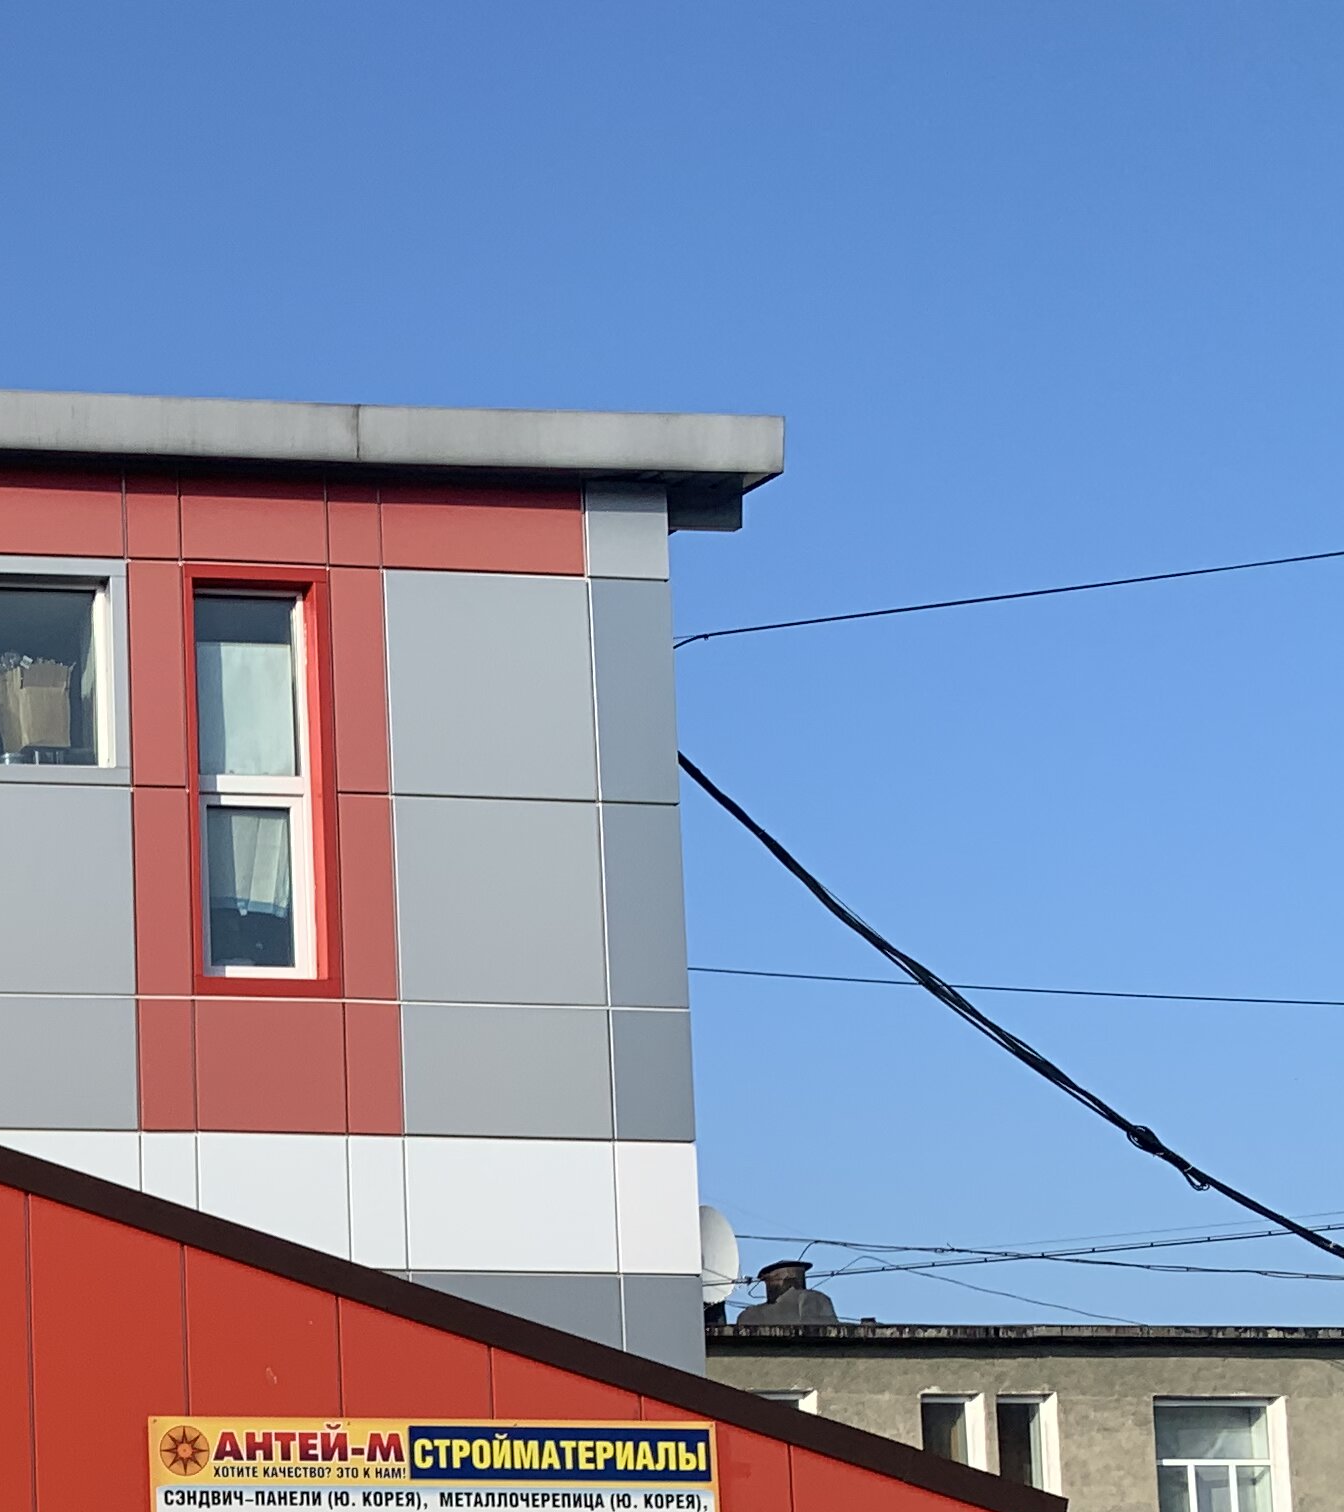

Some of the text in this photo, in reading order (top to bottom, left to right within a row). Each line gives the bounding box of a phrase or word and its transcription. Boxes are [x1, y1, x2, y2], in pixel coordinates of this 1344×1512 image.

[213, 1423, 405, 1463] АНТЕЙ-М
[413, 1433, 707, 1472] СТРОЙМАТЕРИАЛЫ
[213, 1466, 406, 1479] ХОТИТЕ КАЧЕСТВО? ЭТО К НАМ!
[328, 1490, 356, 1510] (Ю.
[362, 1491, 428, 1511] КОРЕЯ),
[440, 1491, 604, 1511] МЕТАЛЛОЧЕРЕПИЦА
[610, 1492, 638, 1512] (Ю.
[644, 1493, 708, 1512] КОРЕЯ),
